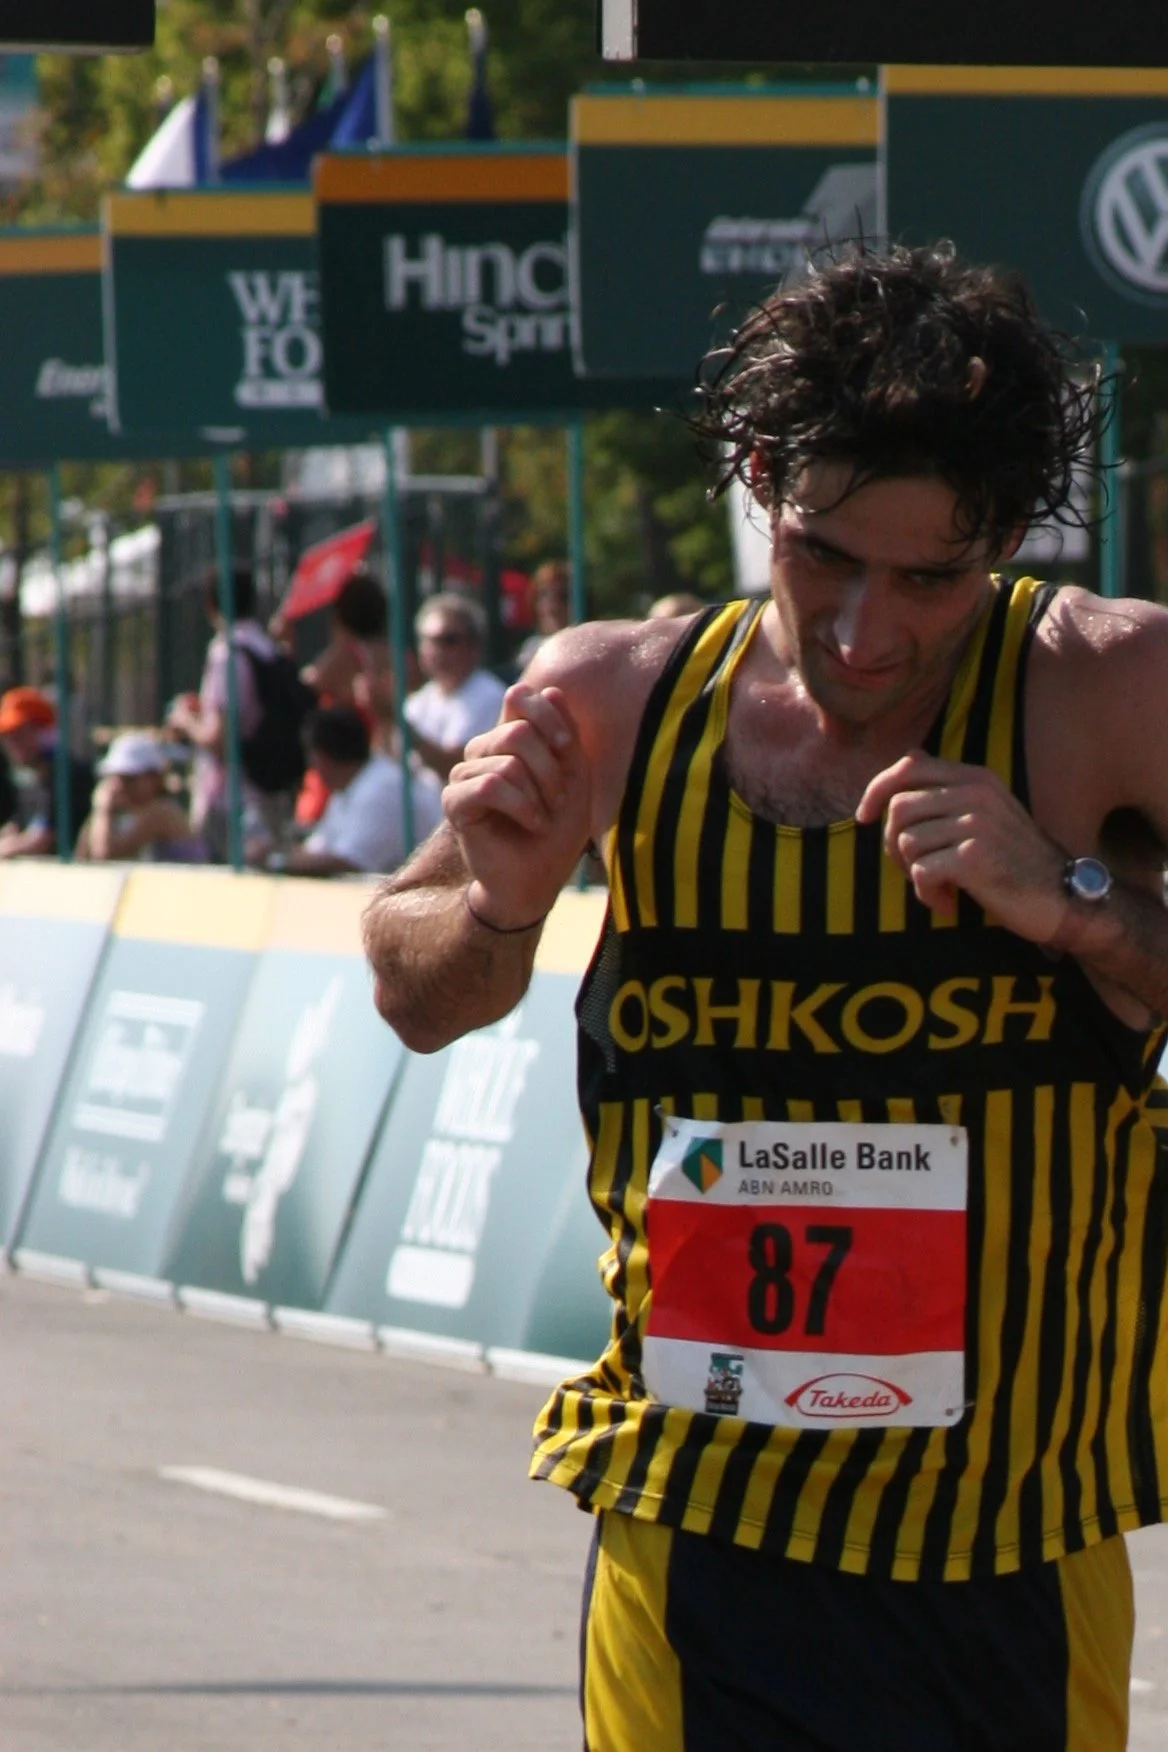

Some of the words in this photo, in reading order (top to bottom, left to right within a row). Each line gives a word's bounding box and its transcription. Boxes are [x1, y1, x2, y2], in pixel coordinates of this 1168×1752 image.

[609, 976, 1056, 1054] OSHKOSH
[739, 1141, 846, 1170] LaSalle
[857, 1143, 931, 1171] Bank
[738, 1180, 775, 1195] ABN
[780, 1181, 834, 1196] AMRO
[747, 1221, 855, 1338] 87
[809, 1389, 893, 1408] Takeda
